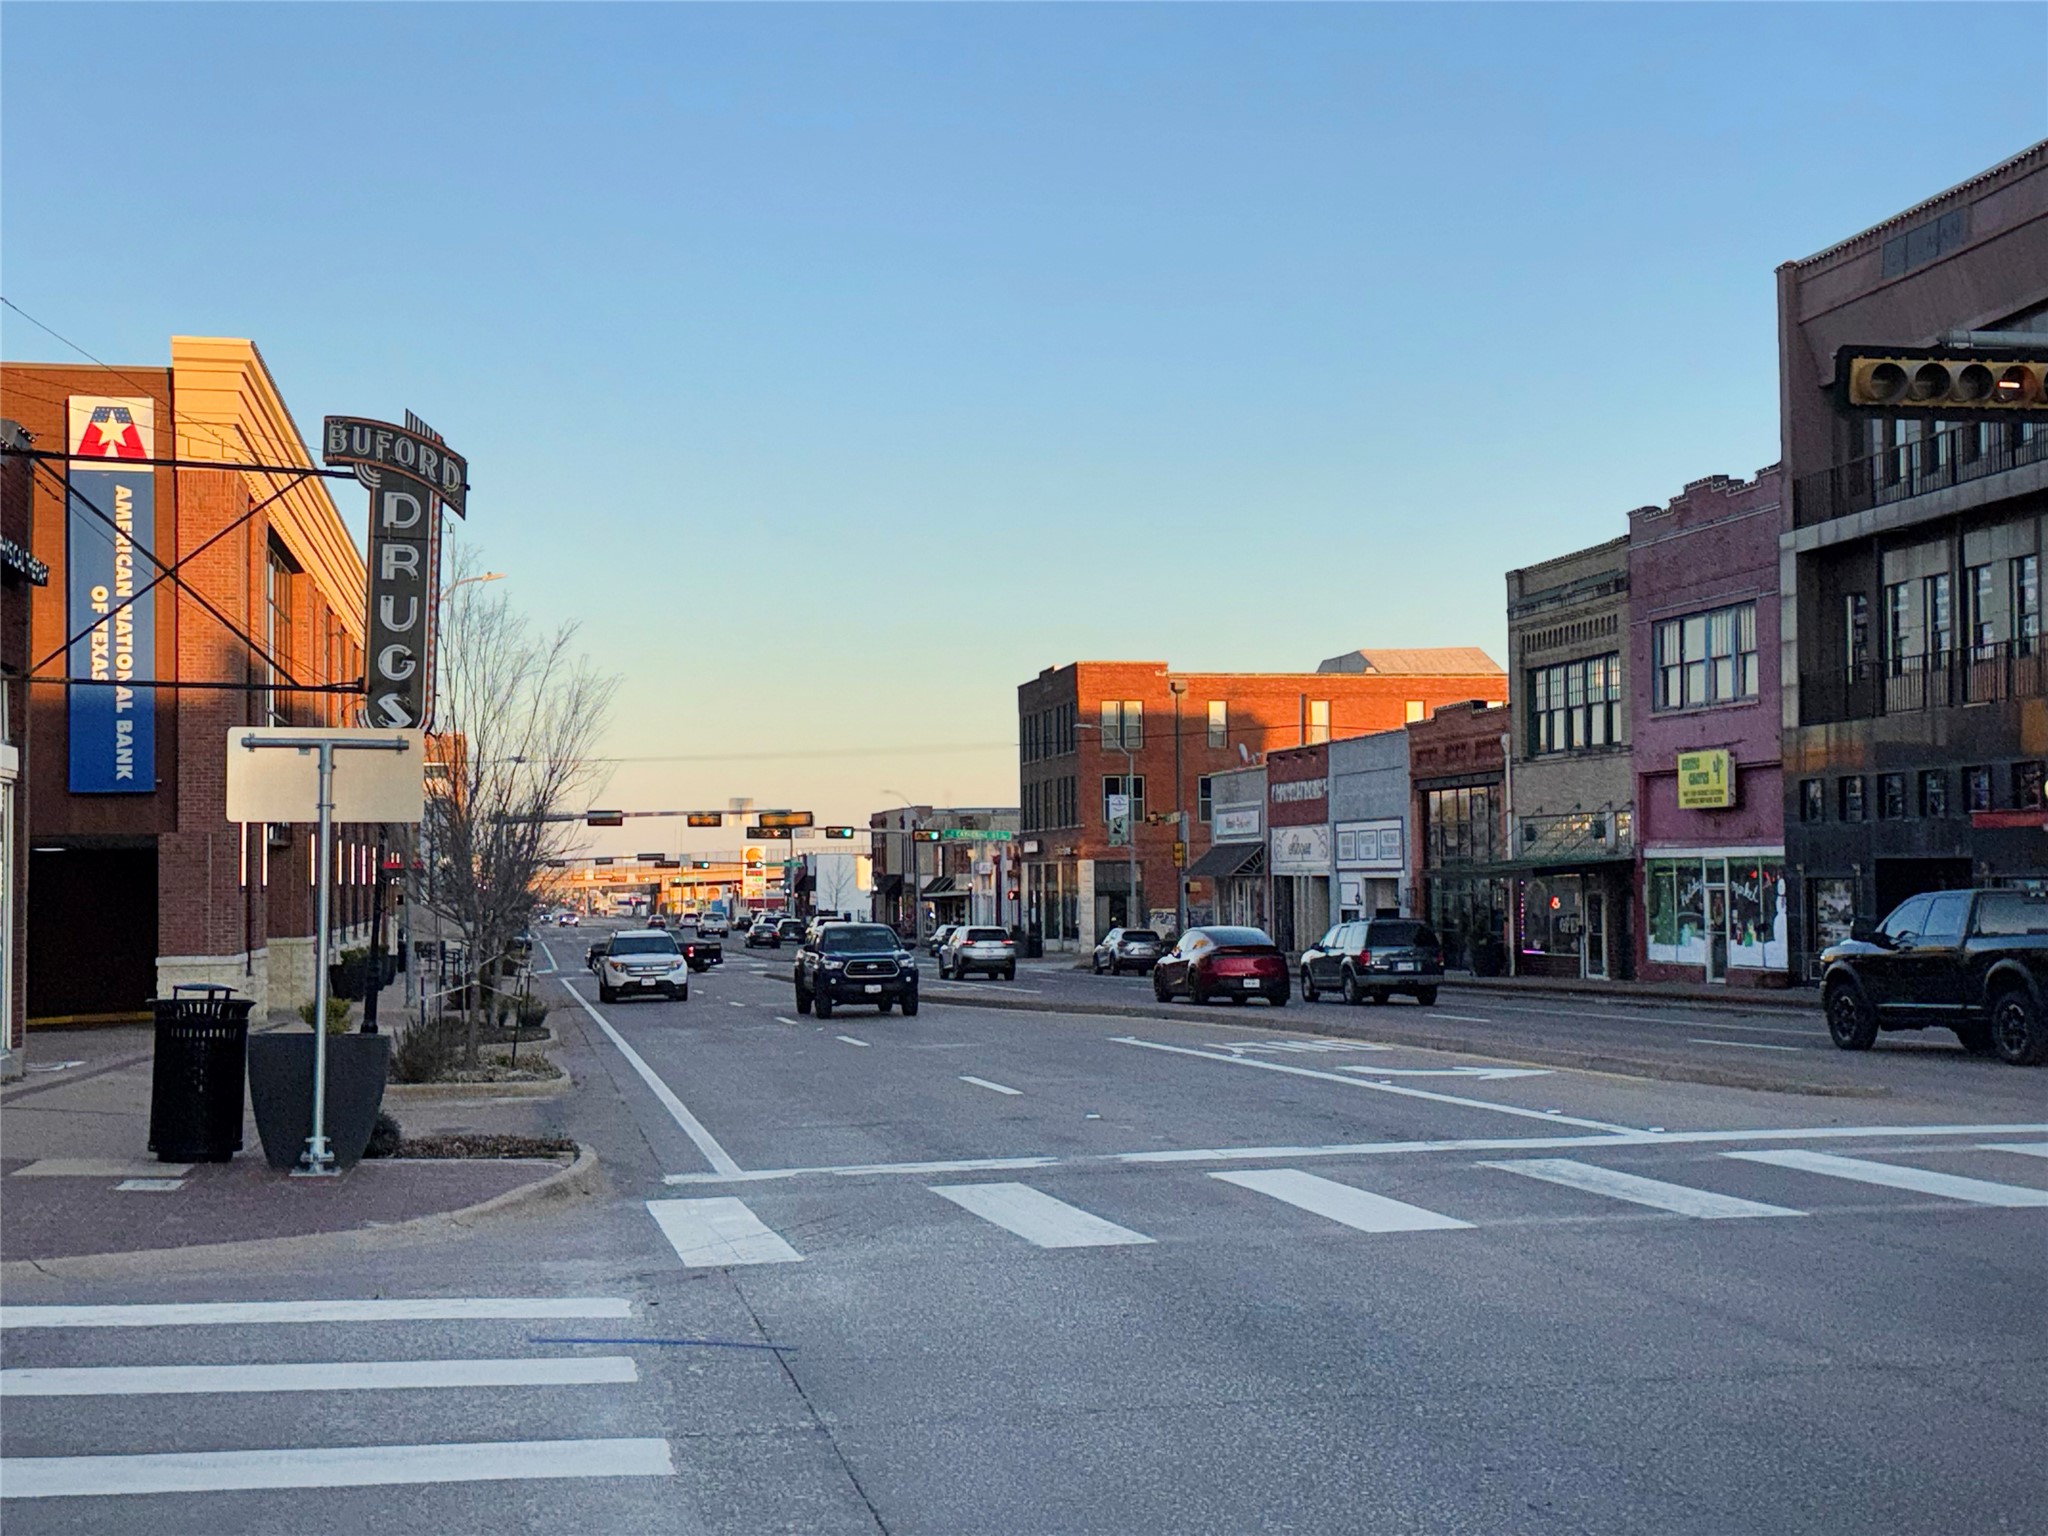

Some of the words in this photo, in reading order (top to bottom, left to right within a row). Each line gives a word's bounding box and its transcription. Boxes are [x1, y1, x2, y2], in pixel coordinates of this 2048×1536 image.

[328, 424, 462, 493] BUFORD
[115, 484, 133, 597] AMERICAN
[91, 585, 110, 614] OF
[377, 491, 421, 729] DRUGS
[91, 621, 110, 682] TEXAS
[115, 604, 133, 713] NATIONAL
[115, 720, 133, 781] BANK
